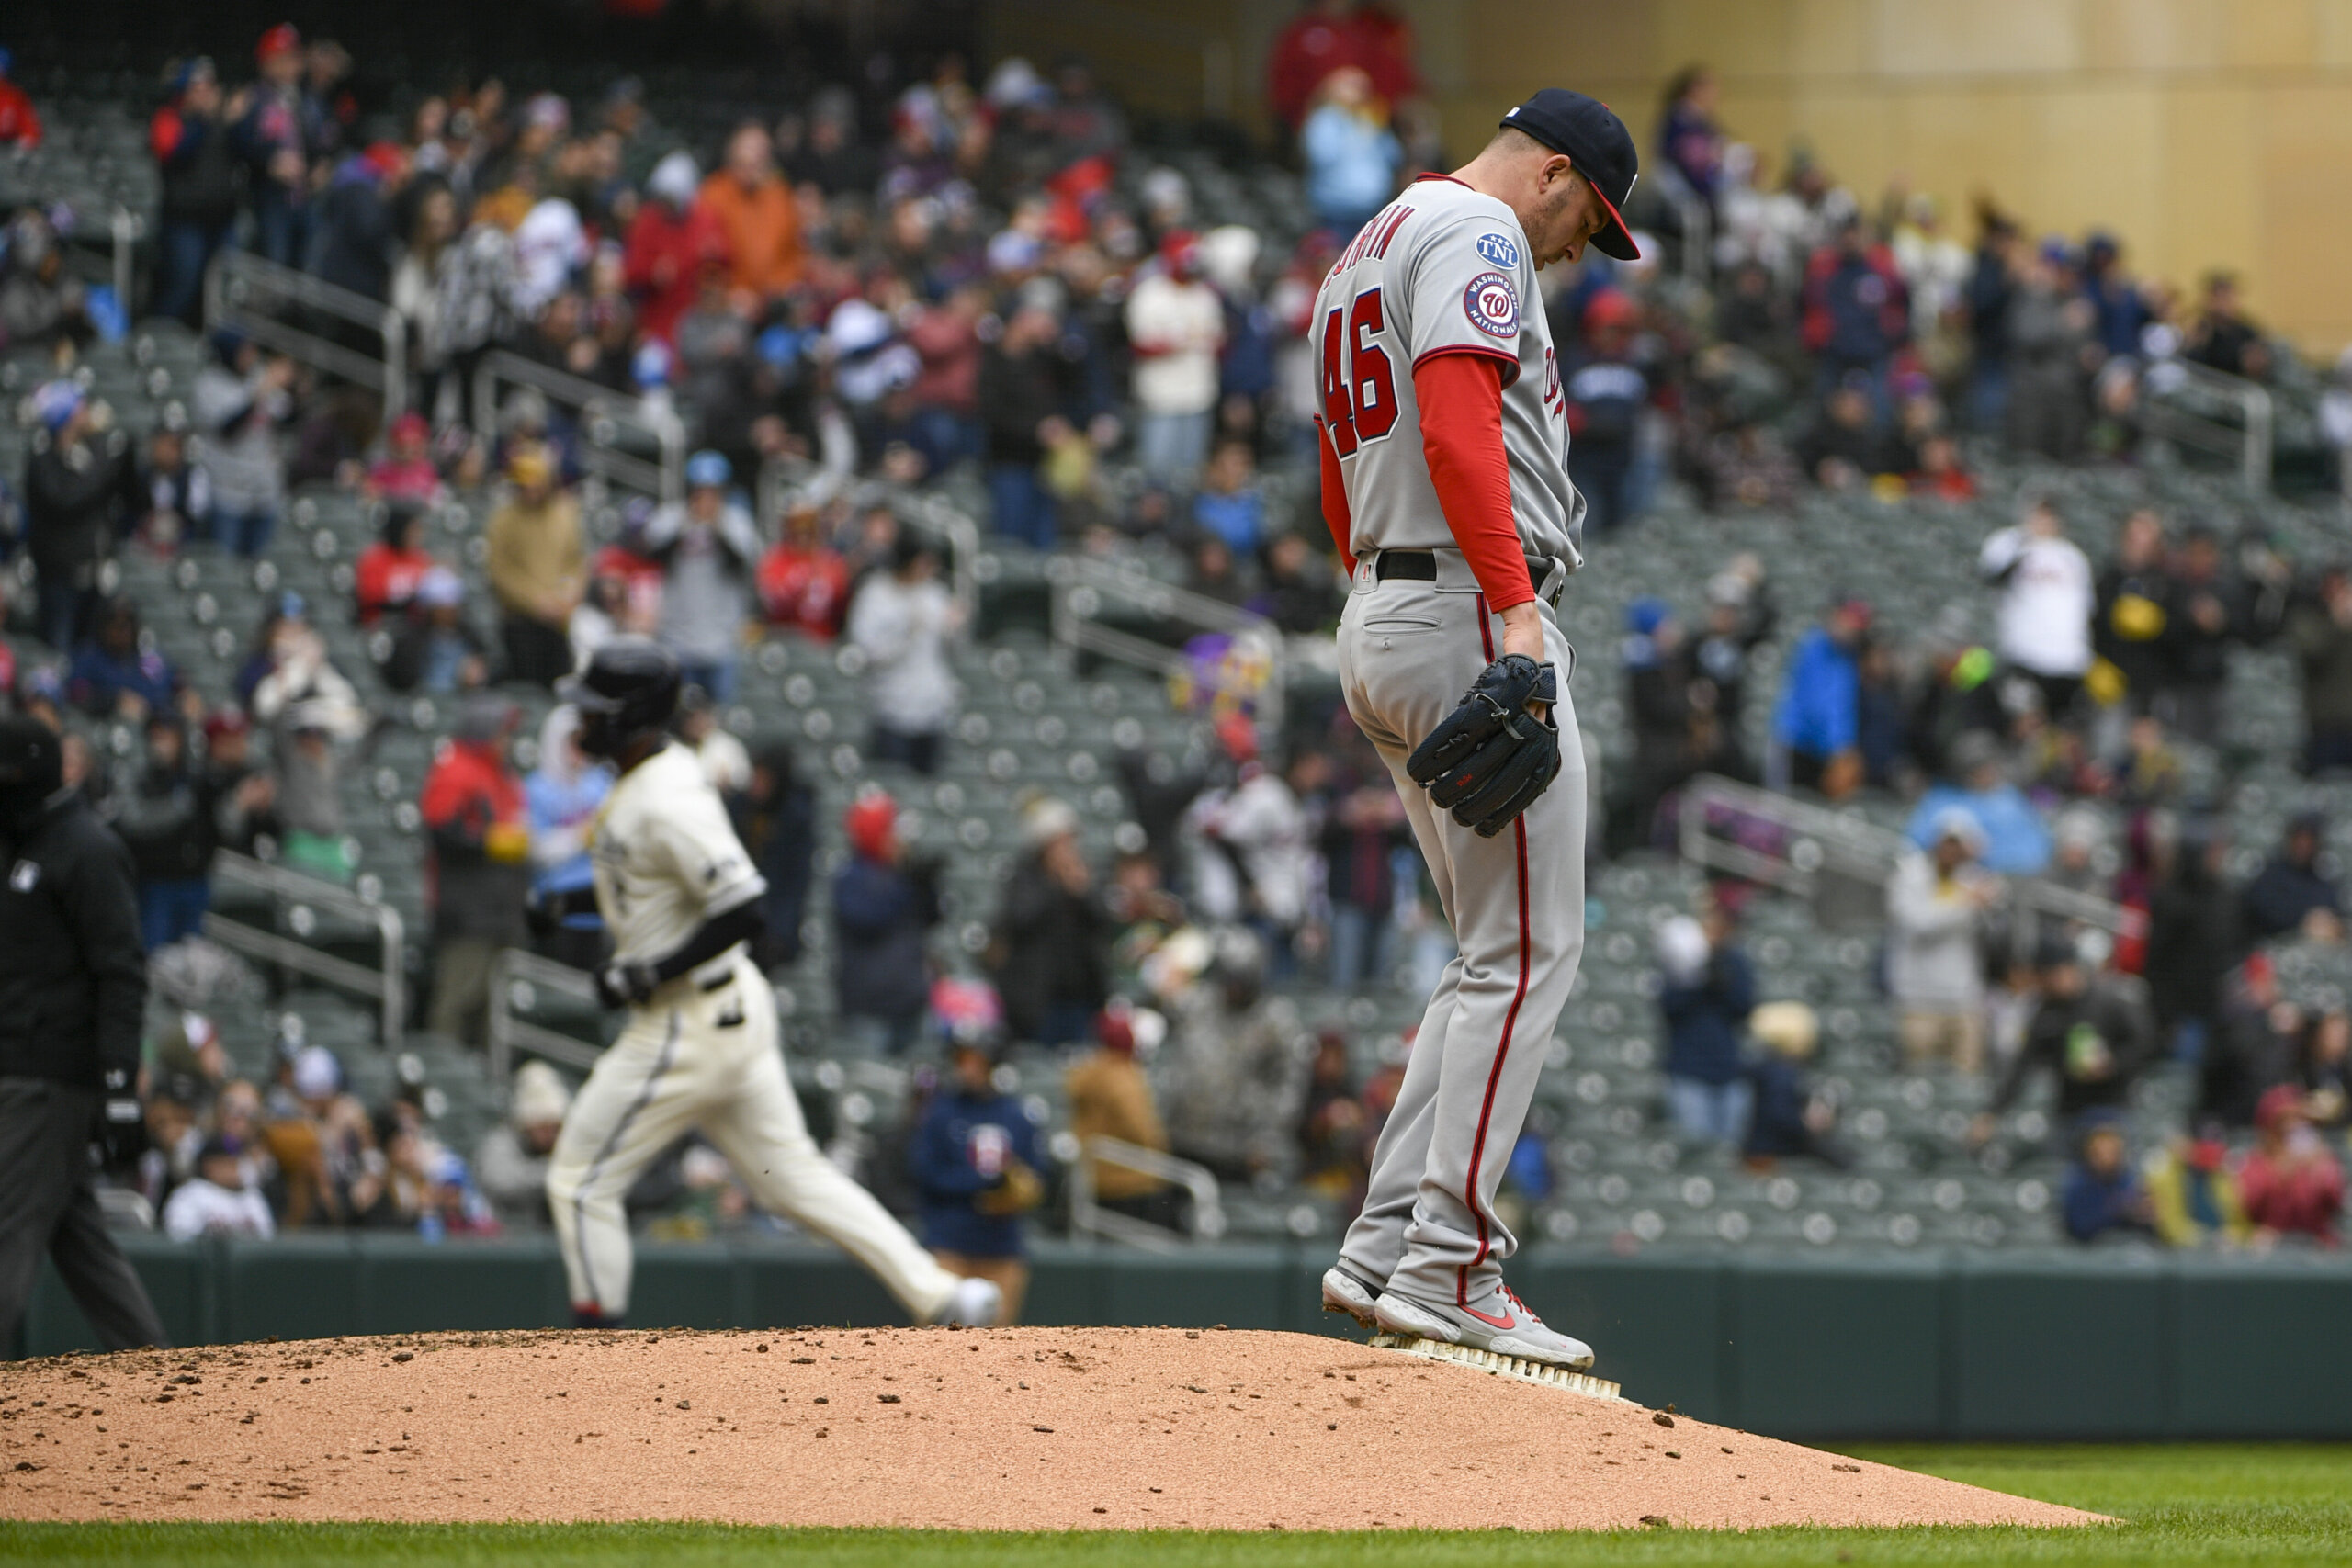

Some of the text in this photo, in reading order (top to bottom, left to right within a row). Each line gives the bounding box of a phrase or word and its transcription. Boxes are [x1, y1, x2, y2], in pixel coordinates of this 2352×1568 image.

[1478, 238, 1517, 266] TNL
[1469, 274, 1519, 310] WASHINGTON
[1470, 309, 1518, 334] NATIONALS
[1322, 284, 1402, 461] 46
